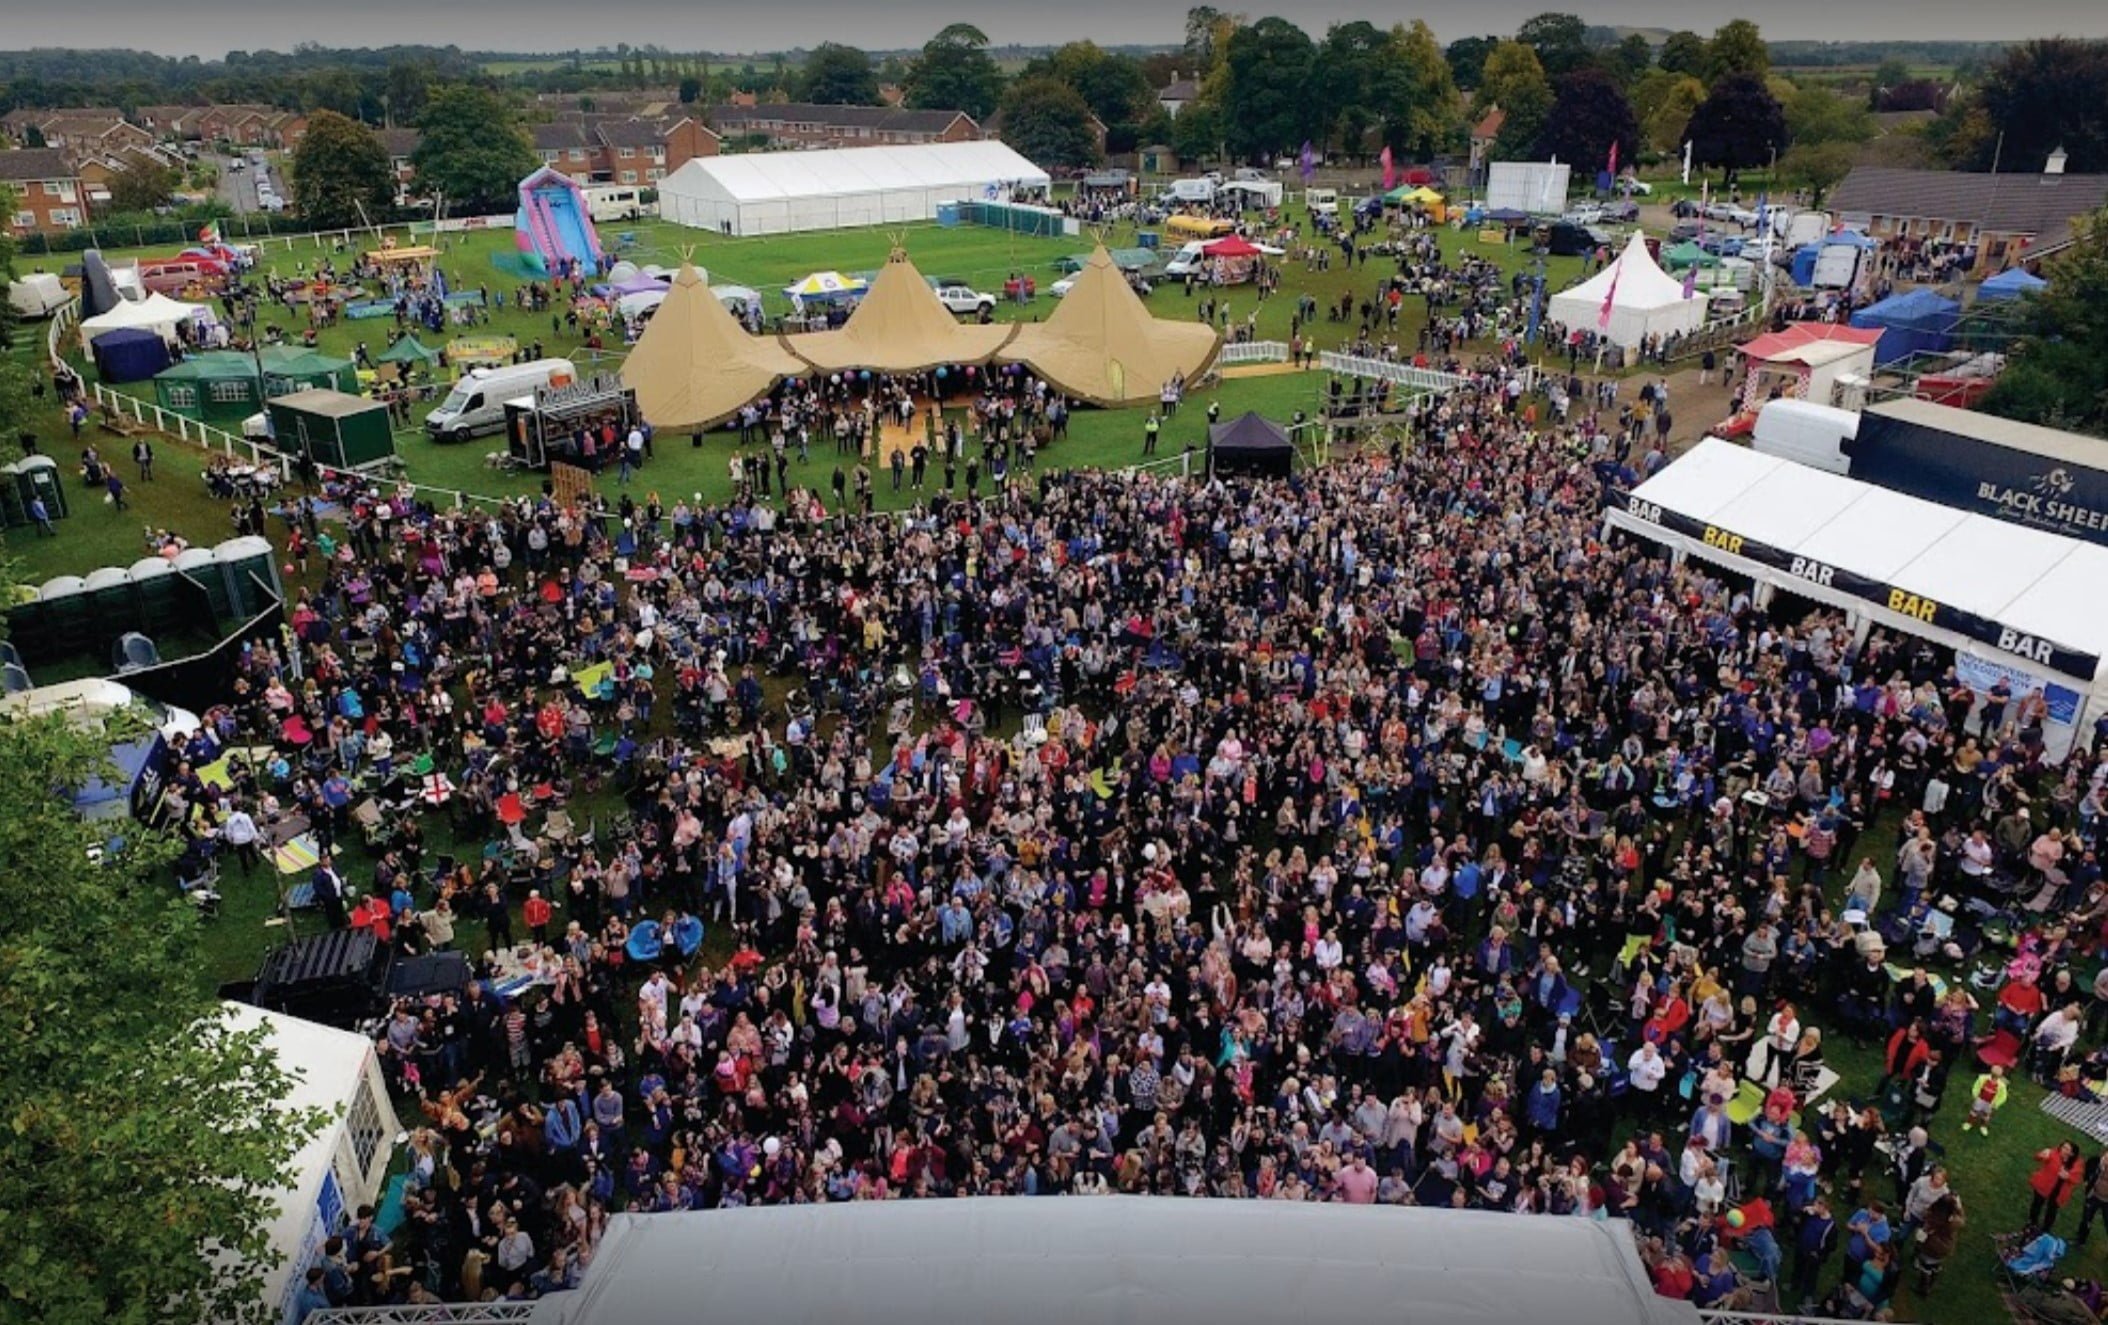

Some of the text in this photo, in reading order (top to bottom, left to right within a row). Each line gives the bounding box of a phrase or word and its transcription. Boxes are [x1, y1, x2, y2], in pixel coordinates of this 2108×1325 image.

[1627, 497, 1661, 524] BAR
[1977, 481, 2042, 514] BLACK
[1702, 526, 1744, 554] BAR
[1790, 556, 1834, 585] BAR
[1887, 588, 1937, 622] BAR
[1998, 626, 2053, 664] BAR
